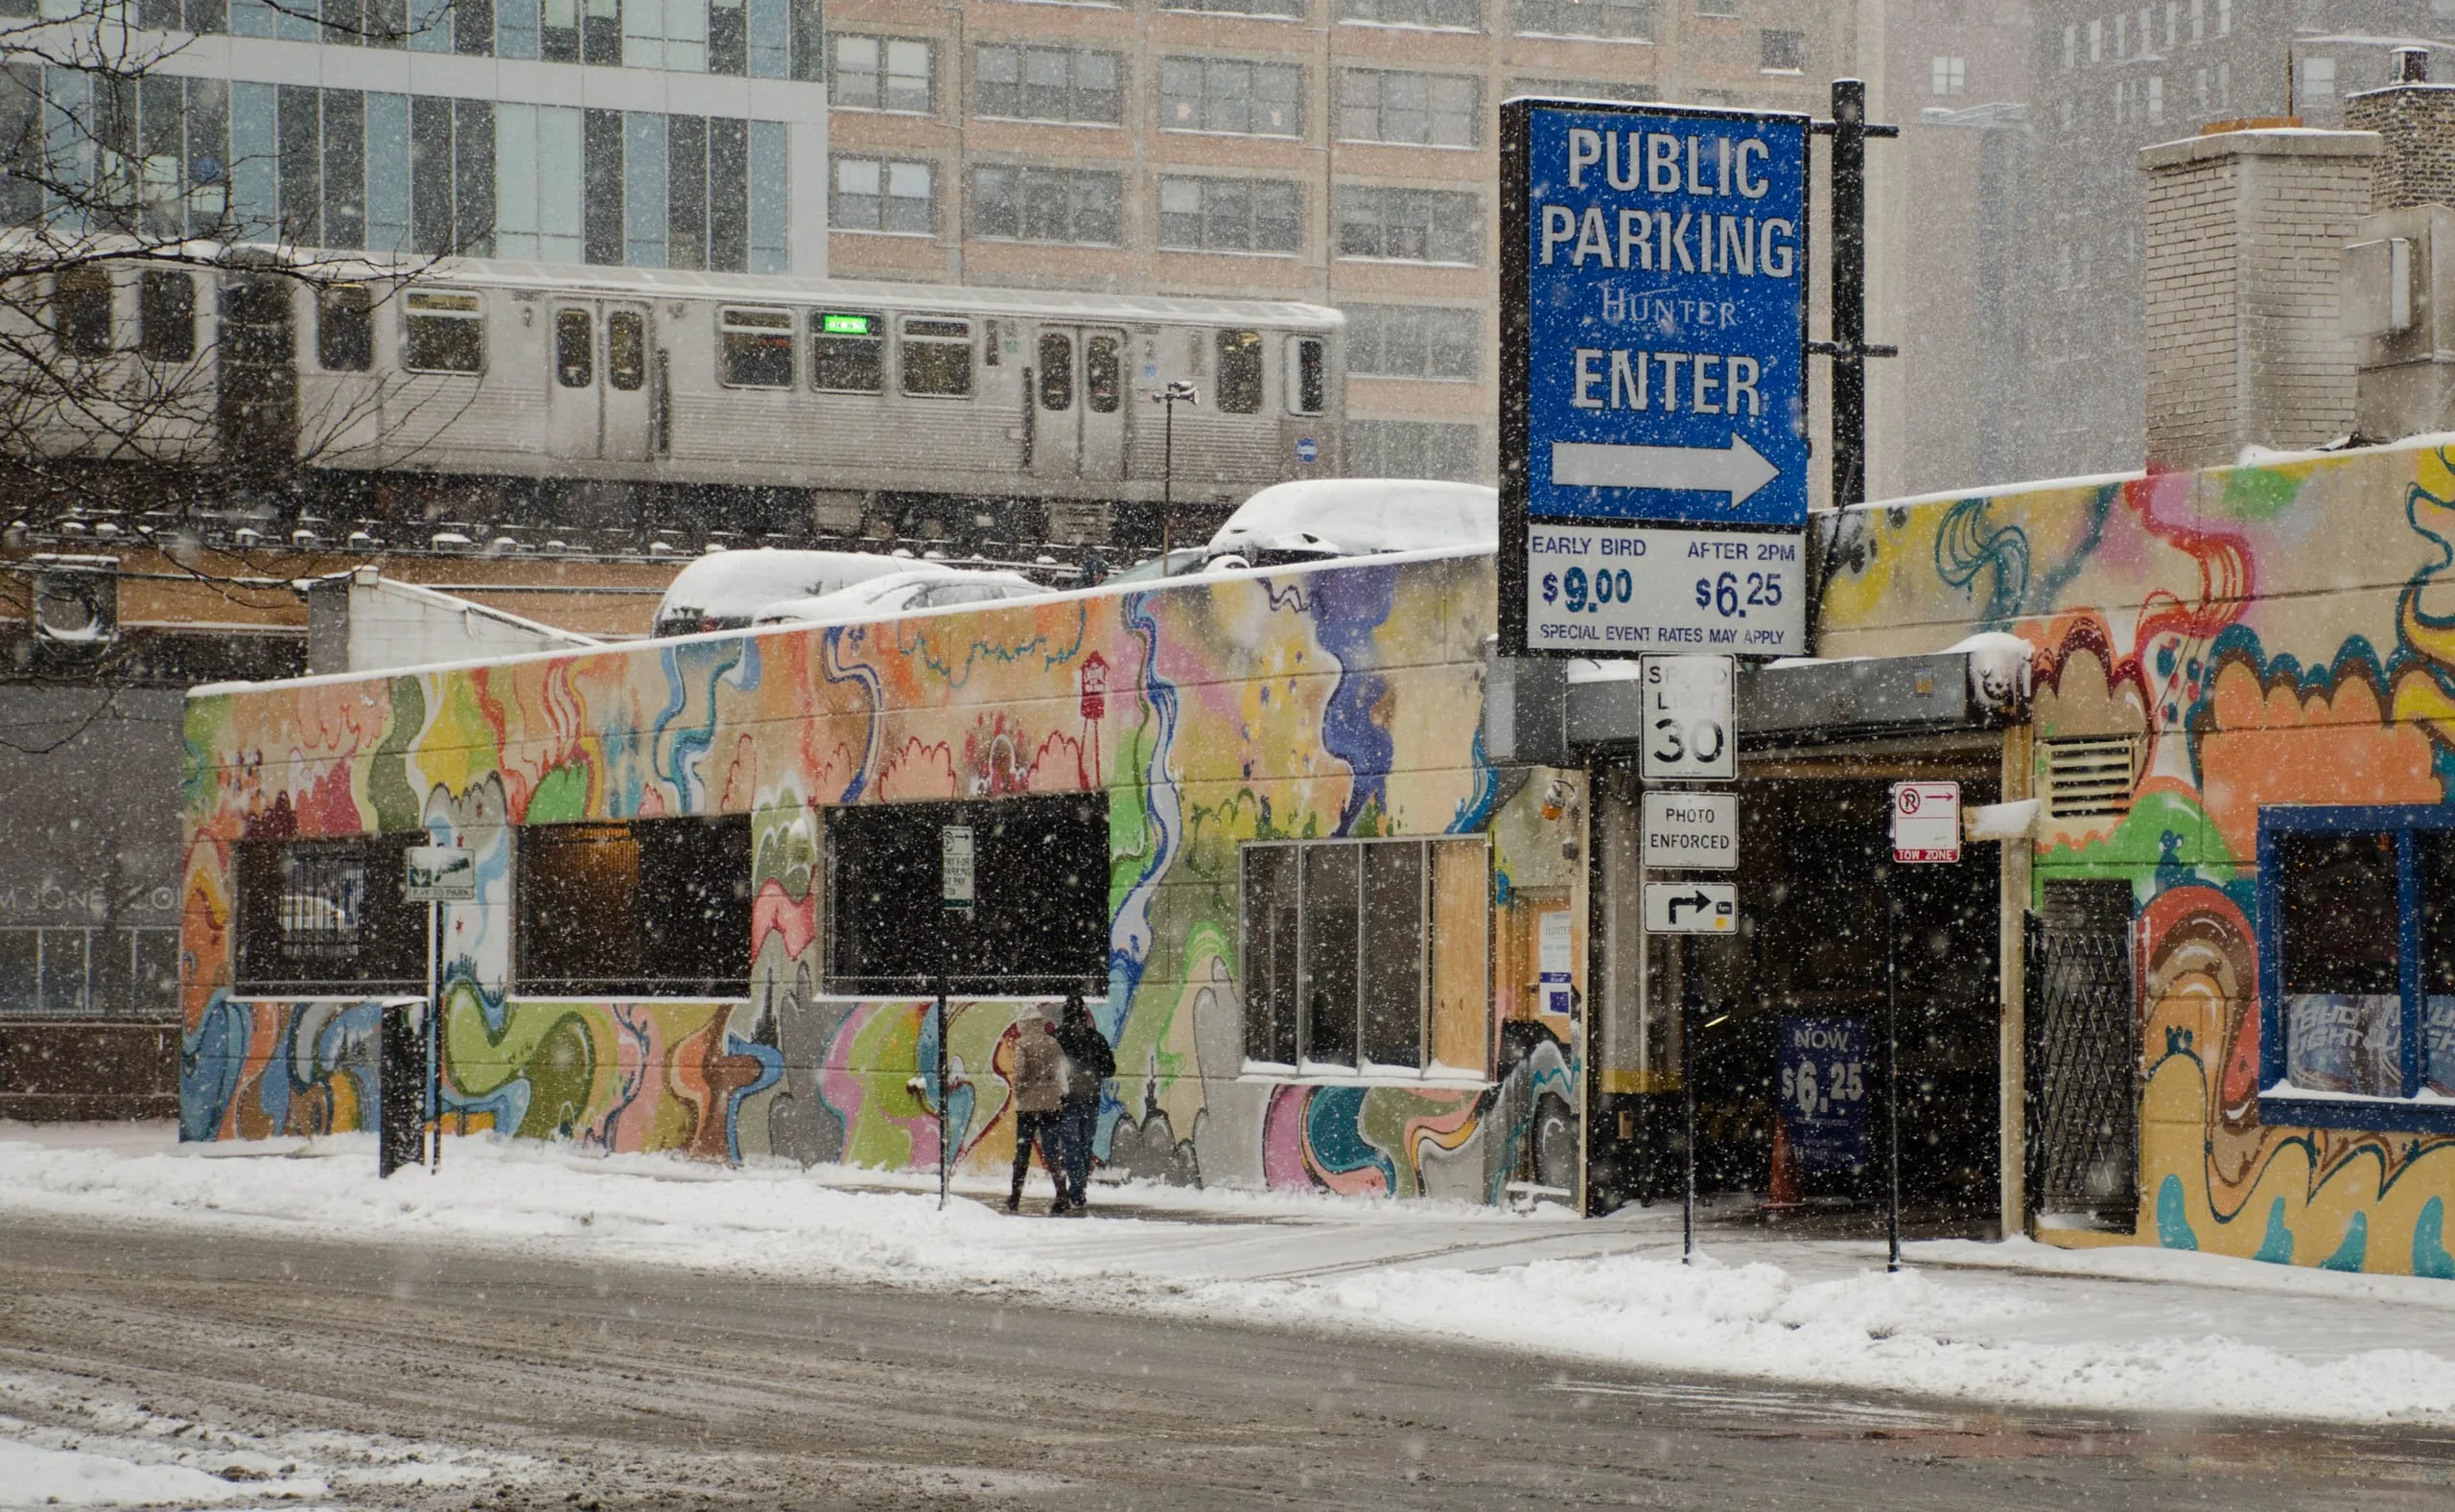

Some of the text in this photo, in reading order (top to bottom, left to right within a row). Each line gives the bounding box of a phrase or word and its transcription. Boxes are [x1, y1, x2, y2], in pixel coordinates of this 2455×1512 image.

[1568, 128, 1770, 199] PUBLIC
[1539, 204, 1793, 278] PARKING
[1602, 288, 1738, 329] HUNTER
[1575, 348, 1761, 416] ENTER
[1531, 535, 1647, 557] EARLY BIRD
[1687, 542, 1795, 562] AFTER 2PM
[1542, 566, 1633, 614] $9.00
[1695, 570, 1783, 618] $6.25
[1539, 623, 1785, 645] SPECIAL EVENT RATES MAY APPLY
[1653, 717, 1725, 764] 30
[1665, 808, 1716, 824] PHOTO
[1649, 833, 1730, 849] ENFORCED
[1898, 850, 1953, 862] TOW ZONE
[27, 884, 108, 912] JONE
[1793, 1029, 1851, 1050] NOW
[1781, 1059, 1864, 1115] $6.25
